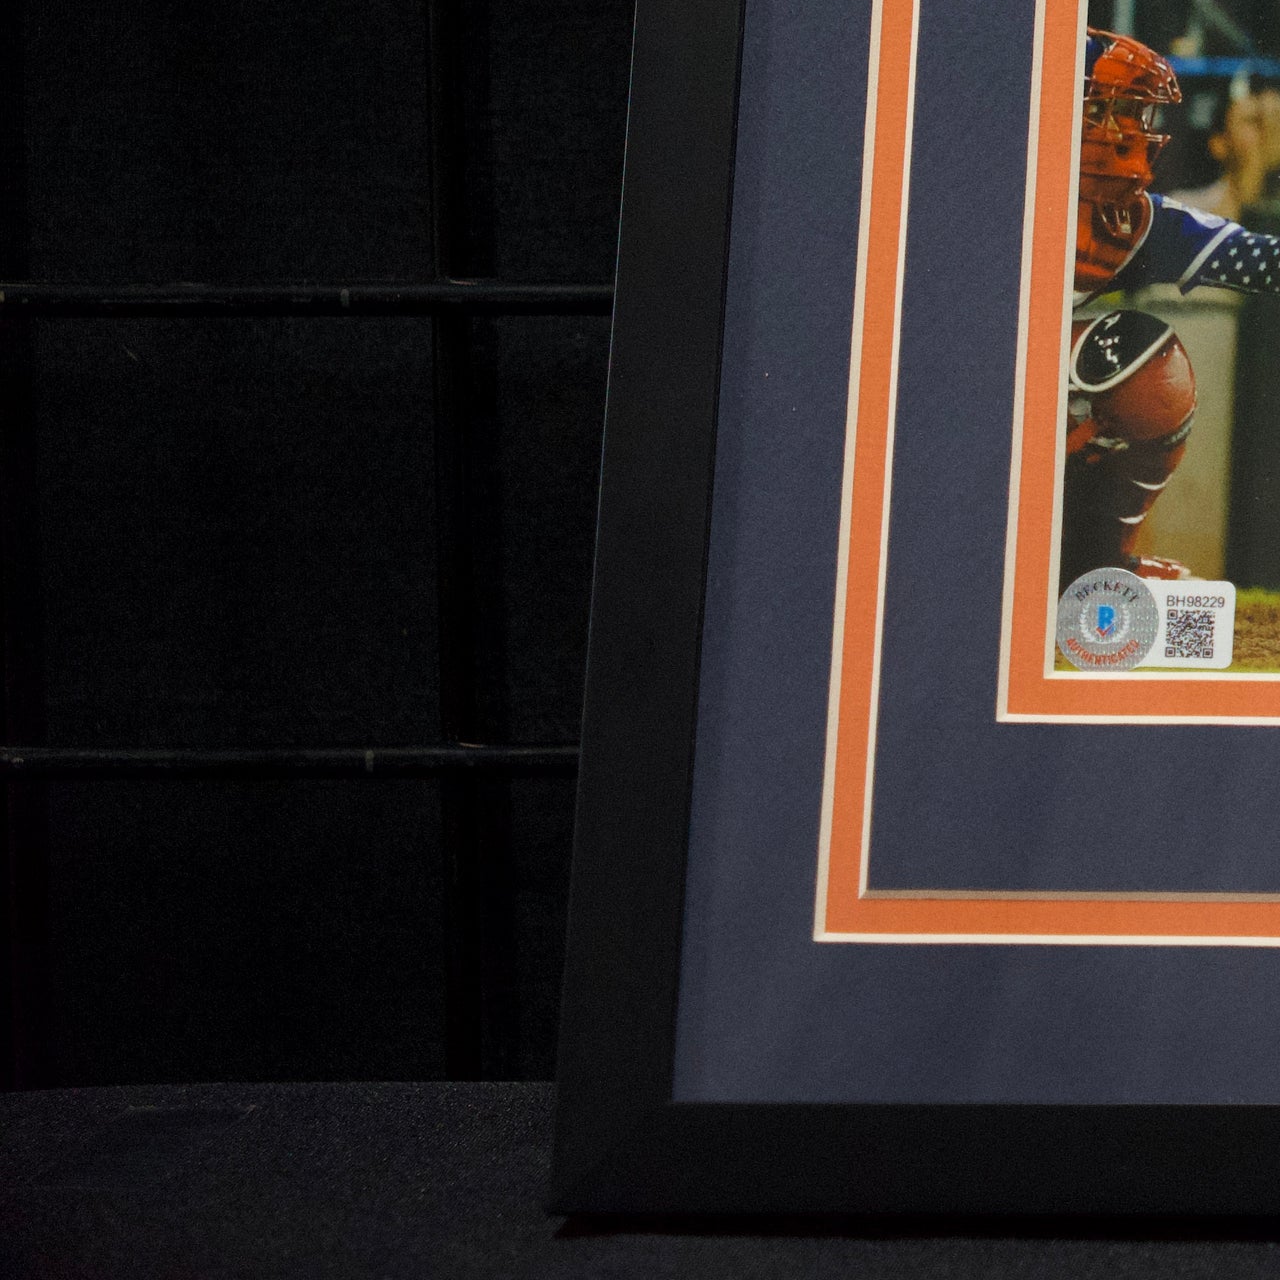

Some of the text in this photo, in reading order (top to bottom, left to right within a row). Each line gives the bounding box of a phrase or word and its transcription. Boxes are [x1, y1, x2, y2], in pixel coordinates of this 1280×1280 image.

[1075, 580, 1141, 604] BECKETT
[1166, 595, 1226, 608] BH98229
[1065, 637, 1141, 665] AUTHENTICATED
